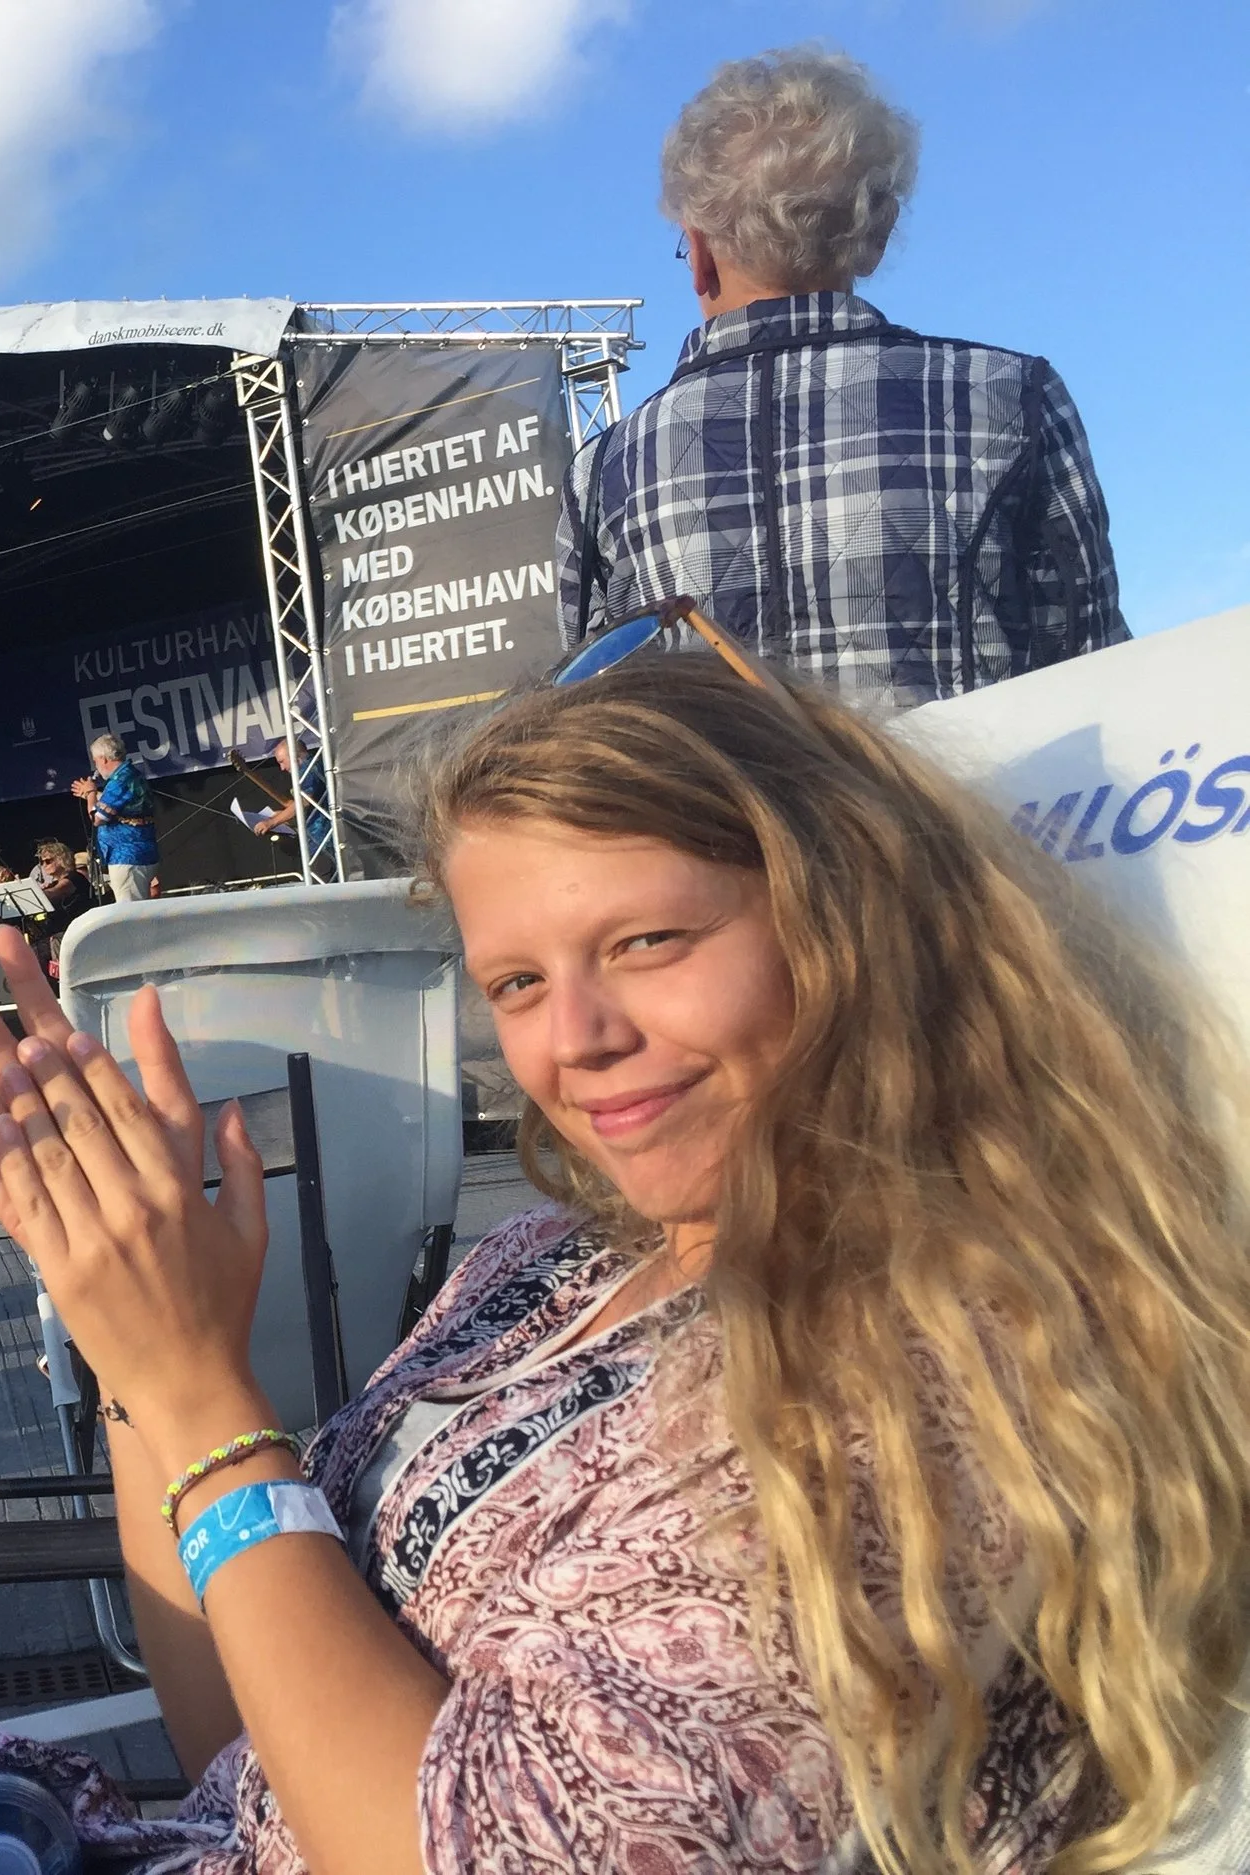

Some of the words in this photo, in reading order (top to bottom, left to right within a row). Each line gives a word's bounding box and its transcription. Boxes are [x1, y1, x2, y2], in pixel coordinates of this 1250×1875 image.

[88, 322, 227, 346] danskmobilscene.dk
[327, 468, 339, 498] I
[343, 429, 486, 494] HJERTET
[496, 415, 540, 458] AF
[333, 465, 555, 544] KØBENHAVN.
[342, 545, 414, 588] MED
[342, 561, 555, 631] KØBENHAVN
[344, 645, 356, 676] I
[362, 618, 514, 674] HJERTET.
[1011, 743, 1250, 862] MLÖS
